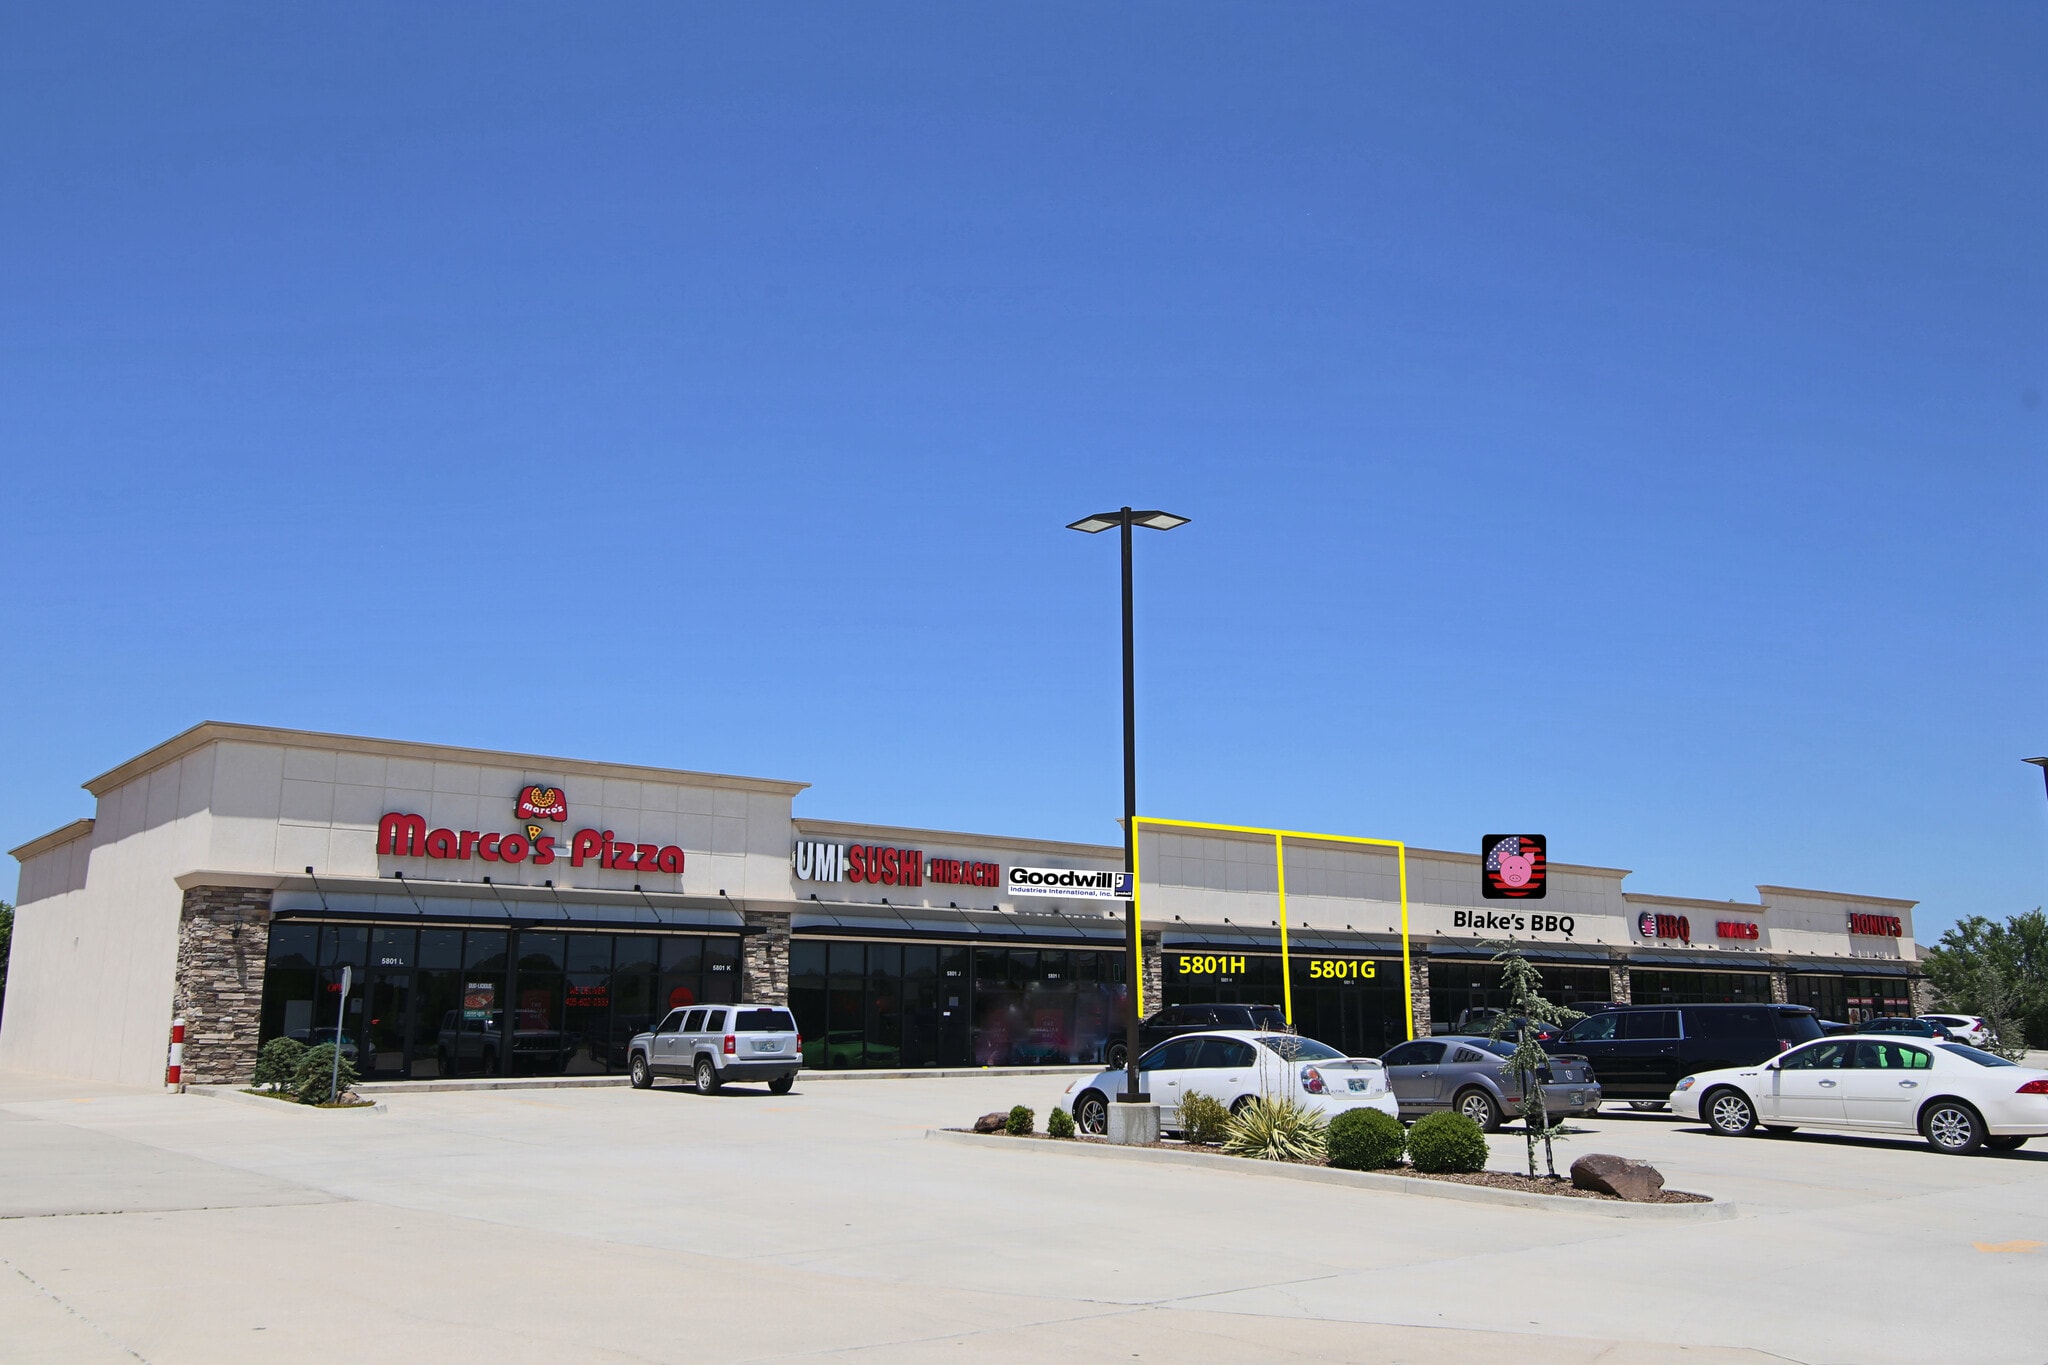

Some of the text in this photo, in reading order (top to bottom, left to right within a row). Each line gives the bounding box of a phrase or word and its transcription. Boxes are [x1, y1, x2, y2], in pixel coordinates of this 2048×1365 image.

[377, 812, 685, 874] Marco's Pizza
[796, 841, 1000, 888] UMI SUSHI HIBACHI
[1656, 914, 1690, 944] BBQ
[1717, 921, 1759, 940] NAILS
[1850, 912, 1903, 938] DONUTS
[381, 957, 398, 965] 5801
